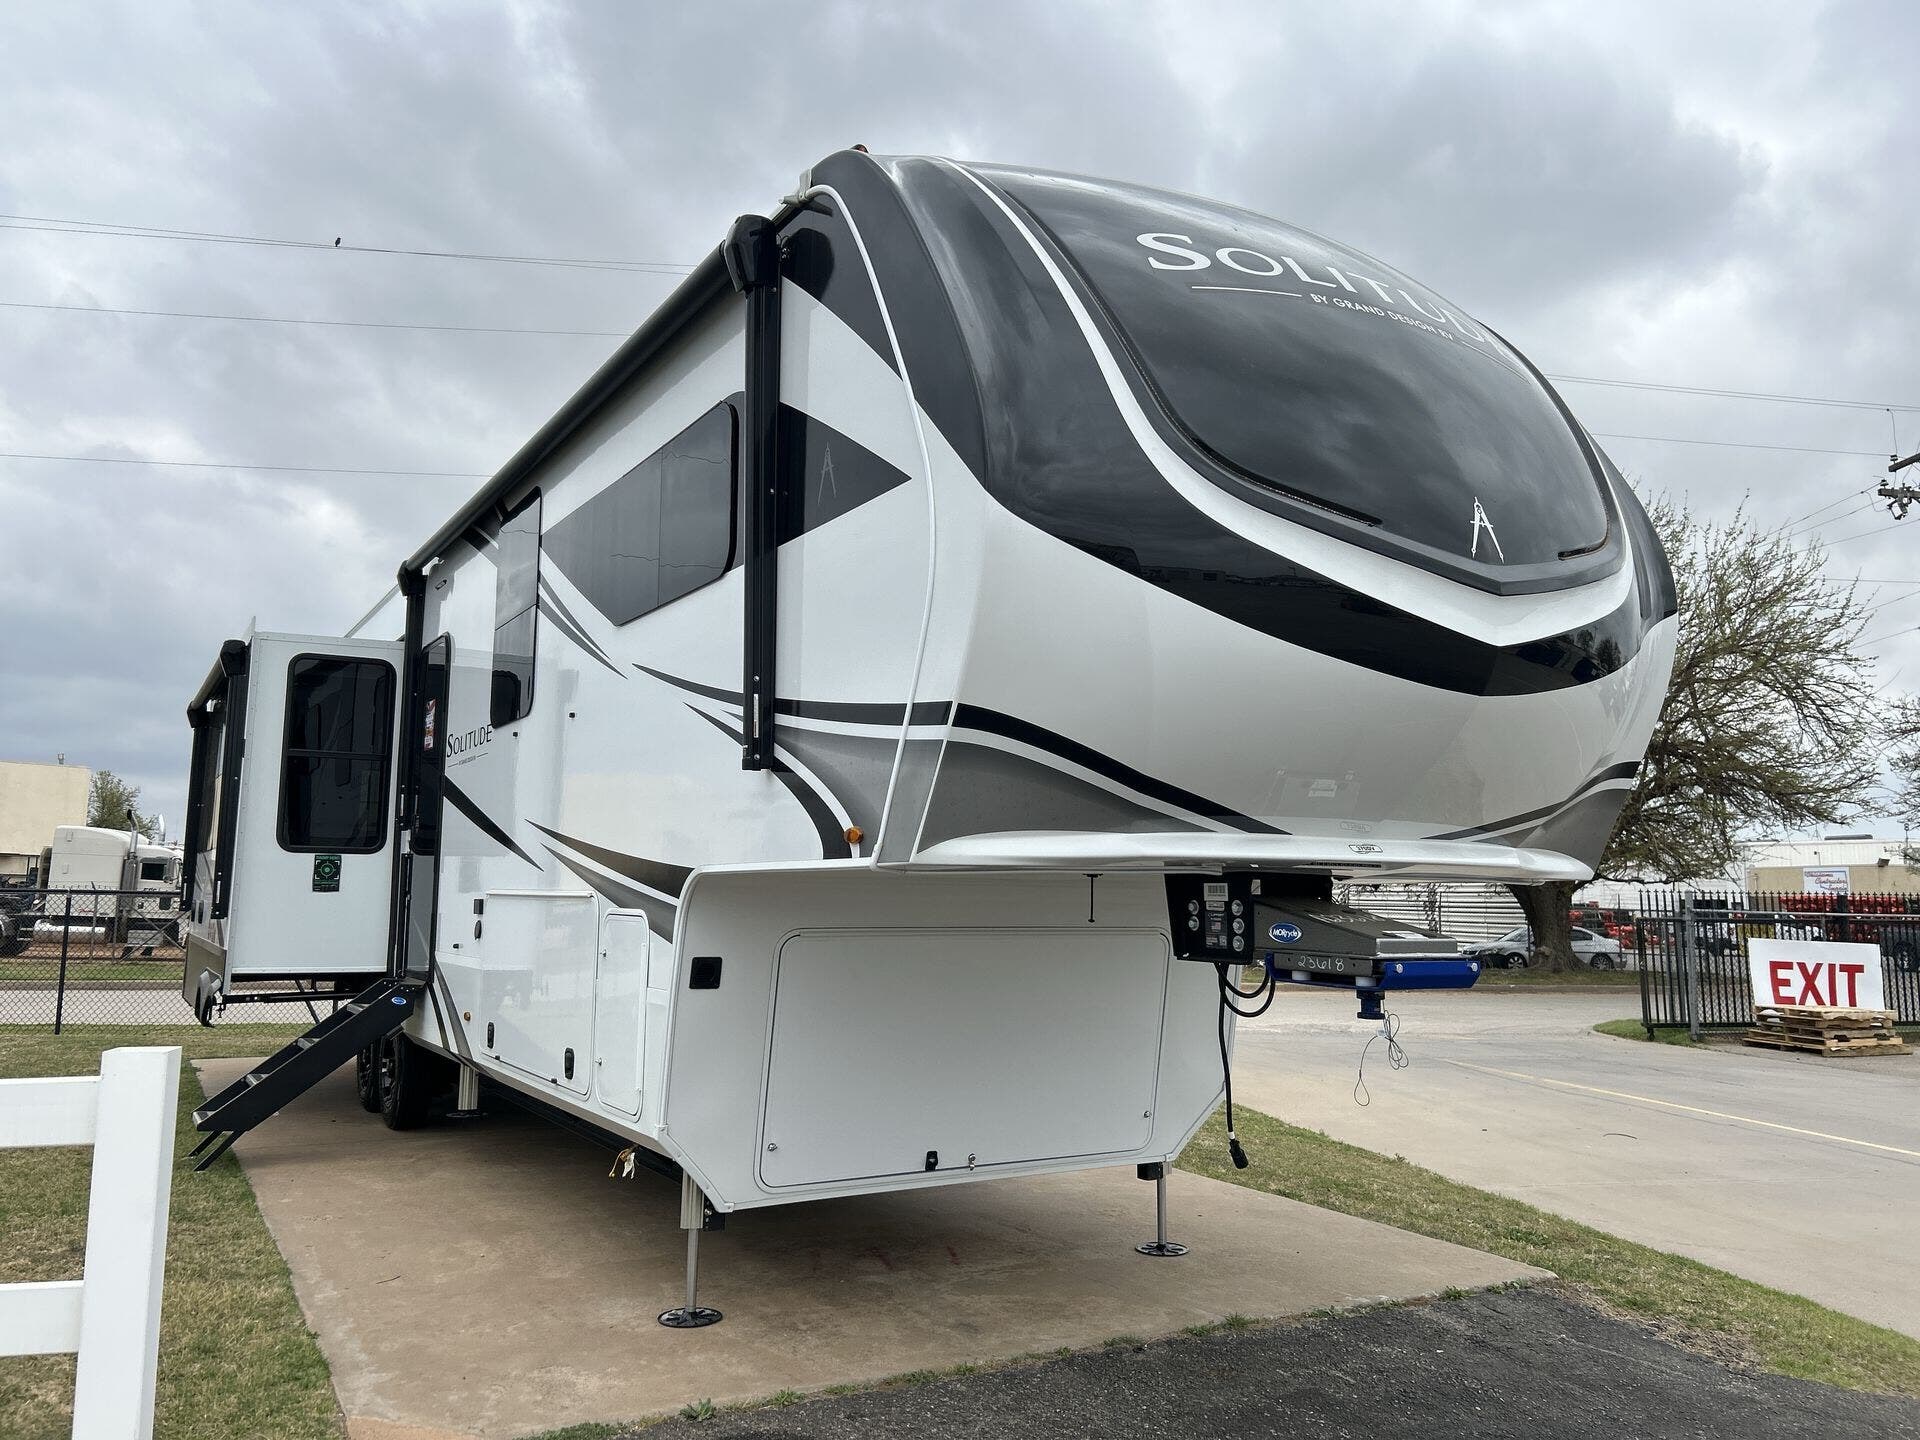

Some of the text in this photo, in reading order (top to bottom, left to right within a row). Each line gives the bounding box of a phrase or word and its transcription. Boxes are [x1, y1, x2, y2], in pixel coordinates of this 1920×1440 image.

[1310, 293, 1329, 305] BY
[1332, 297, 1385, 317] GRAND
[1386, 310, 1437, 335] DESIGN
[446, 723, 494, 759] SOLITUDE
[1298, 955, 1345, 972] 23618
[1768, 960, 1866, 1008] EXIT
